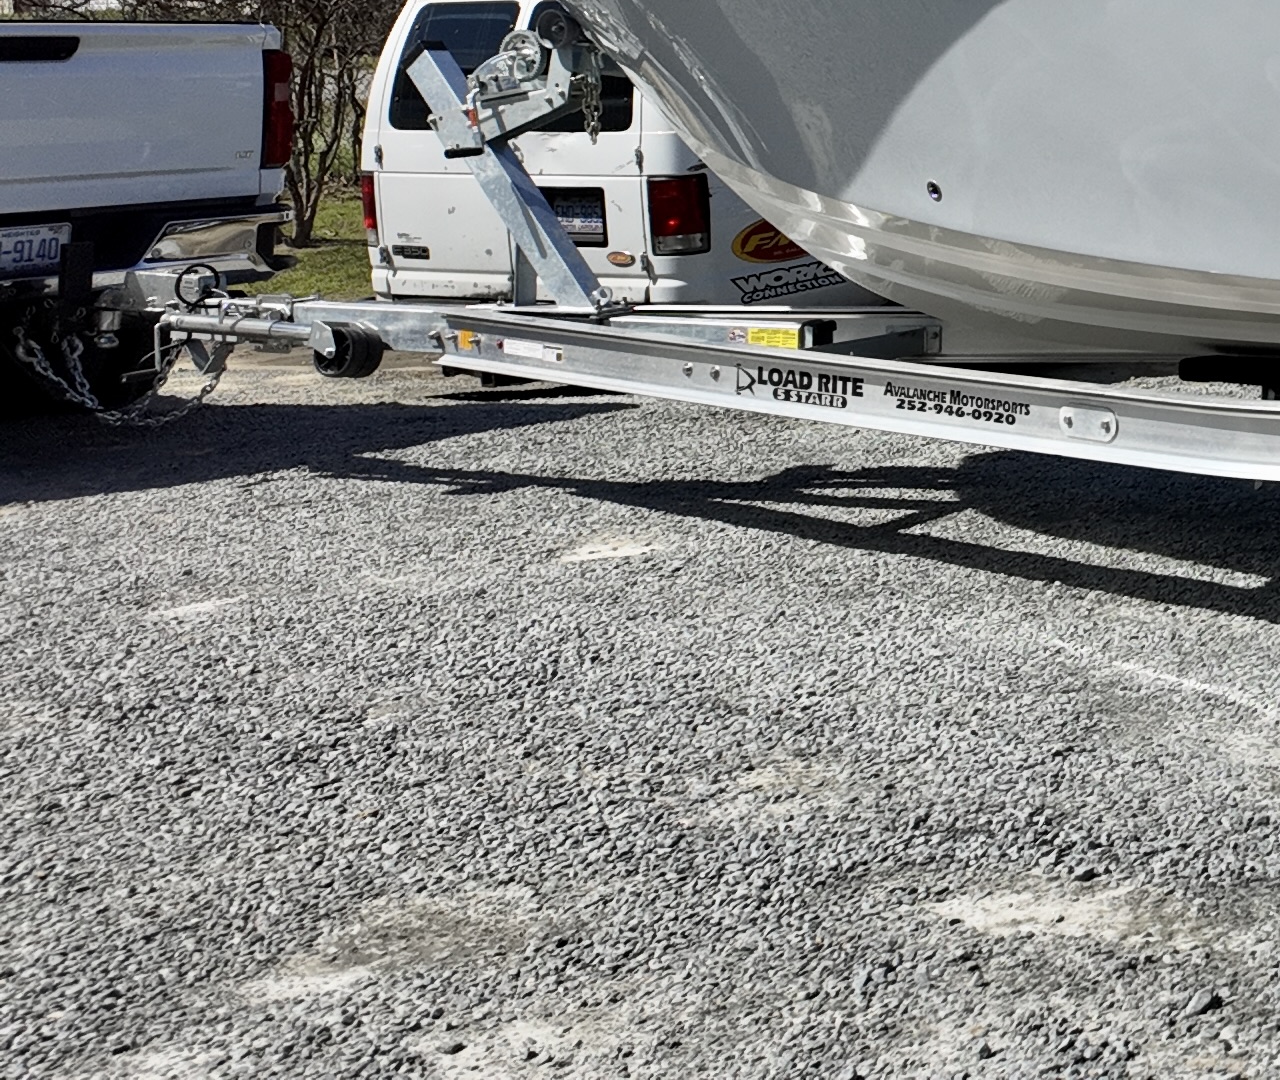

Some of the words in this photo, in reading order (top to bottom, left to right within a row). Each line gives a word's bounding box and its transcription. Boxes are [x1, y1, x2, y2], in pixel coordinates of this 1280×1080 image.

[741, 273, 847, 304] CONNECTION
[757, 366, 813, 390] LOAD
[818, 373, 865, 397] RITE
[776, 388, 786, 400] 5
[789, 392, 843, 408] STARR
[896, 398, 1016, 425] 252-946-0920
